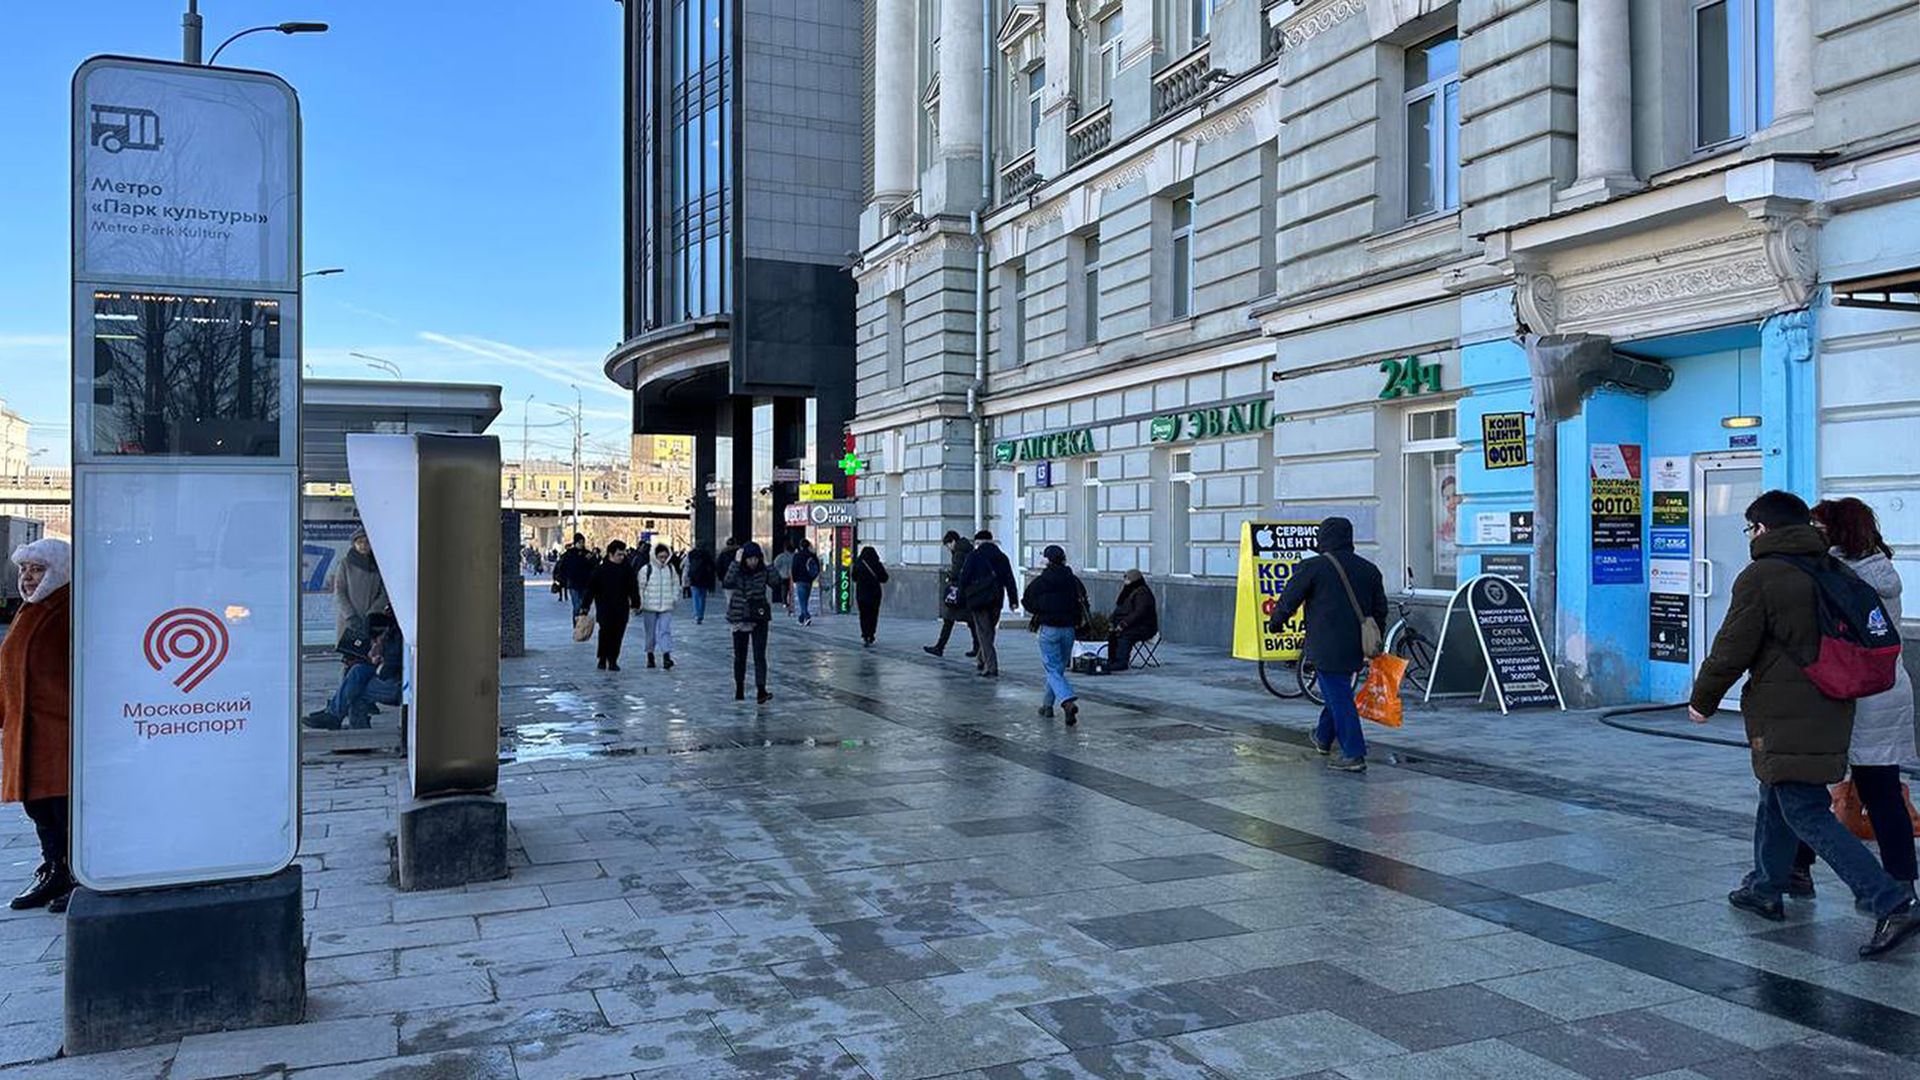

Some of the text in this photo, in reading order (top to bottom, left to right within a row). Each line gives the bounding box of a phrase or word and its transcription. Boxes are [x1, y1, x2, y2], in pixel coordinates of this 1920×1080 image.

[91, 177, 163, 197] Метро
[91, 199, 268, 225] «Парк культуры»
[91, 221, 231, 240] Metro Park Kultury
[1379, 355, 1442, 399] 24ч
[1489, 418, 1520, 430] КОПИ
[1488, 429, 1522, 442] ЦЕНТР
[1016, 428, 1096, 461] АПТЕКА
[1489, 445, 1523, 463] ФОТО
[1592, 497, 1633, 513] ФОТО
[1276, 525, 1320, 537] СЕРВИС
[1272, 552, 1302, 560] ВХОД
[1260, 579, 1288, 596] ЦЕ
[1479, 615, 1529, 624] ЭКСПЕРТИЗА
[1491, 637, 1530, 645] ПРОДАЖА
[124, 697, 251, 718] Московский
[134, 717, 247, 739] Транспорт
